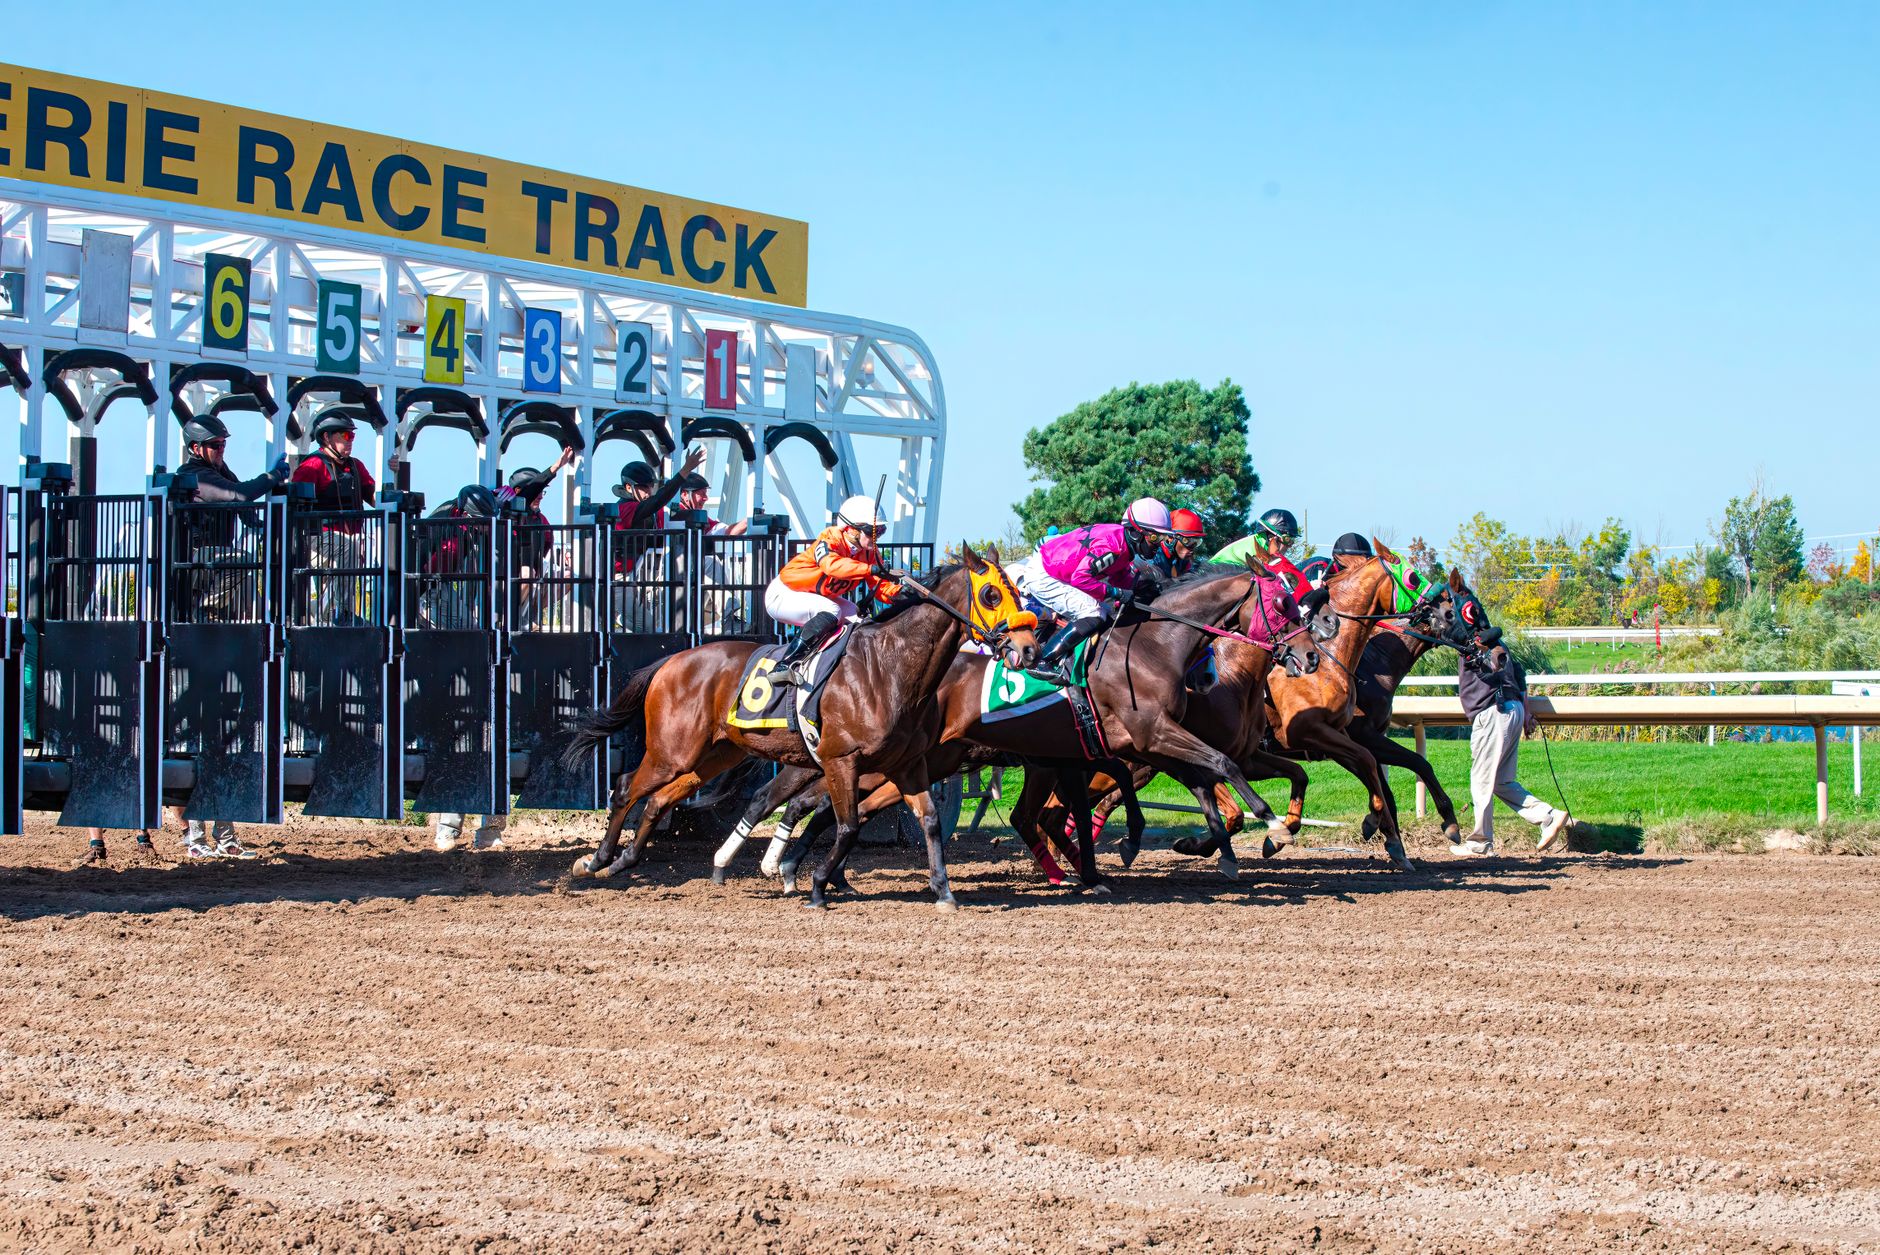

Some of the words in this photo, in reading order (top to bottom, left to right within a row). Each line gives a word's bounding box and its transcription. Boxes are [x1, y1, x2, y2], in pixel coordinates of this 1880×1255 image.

[0, 82, 200, 195] RIE
[237, 125, 487, 243] RACE
[521, 180, 778, 295] TRACK
[211, 265, 244, 340] 6
[324, 292, 355, 362] 5
[430, 307, 460, 373] 4
[530, 318, 557, 384] 3
[622, 331, 648, 395] 2
[712, 336, 729, 400] 1
[1096, 552, 1115, 573] 5
[741, 657, 777, 713] 6
[998, 666, 1026, 704] 5
